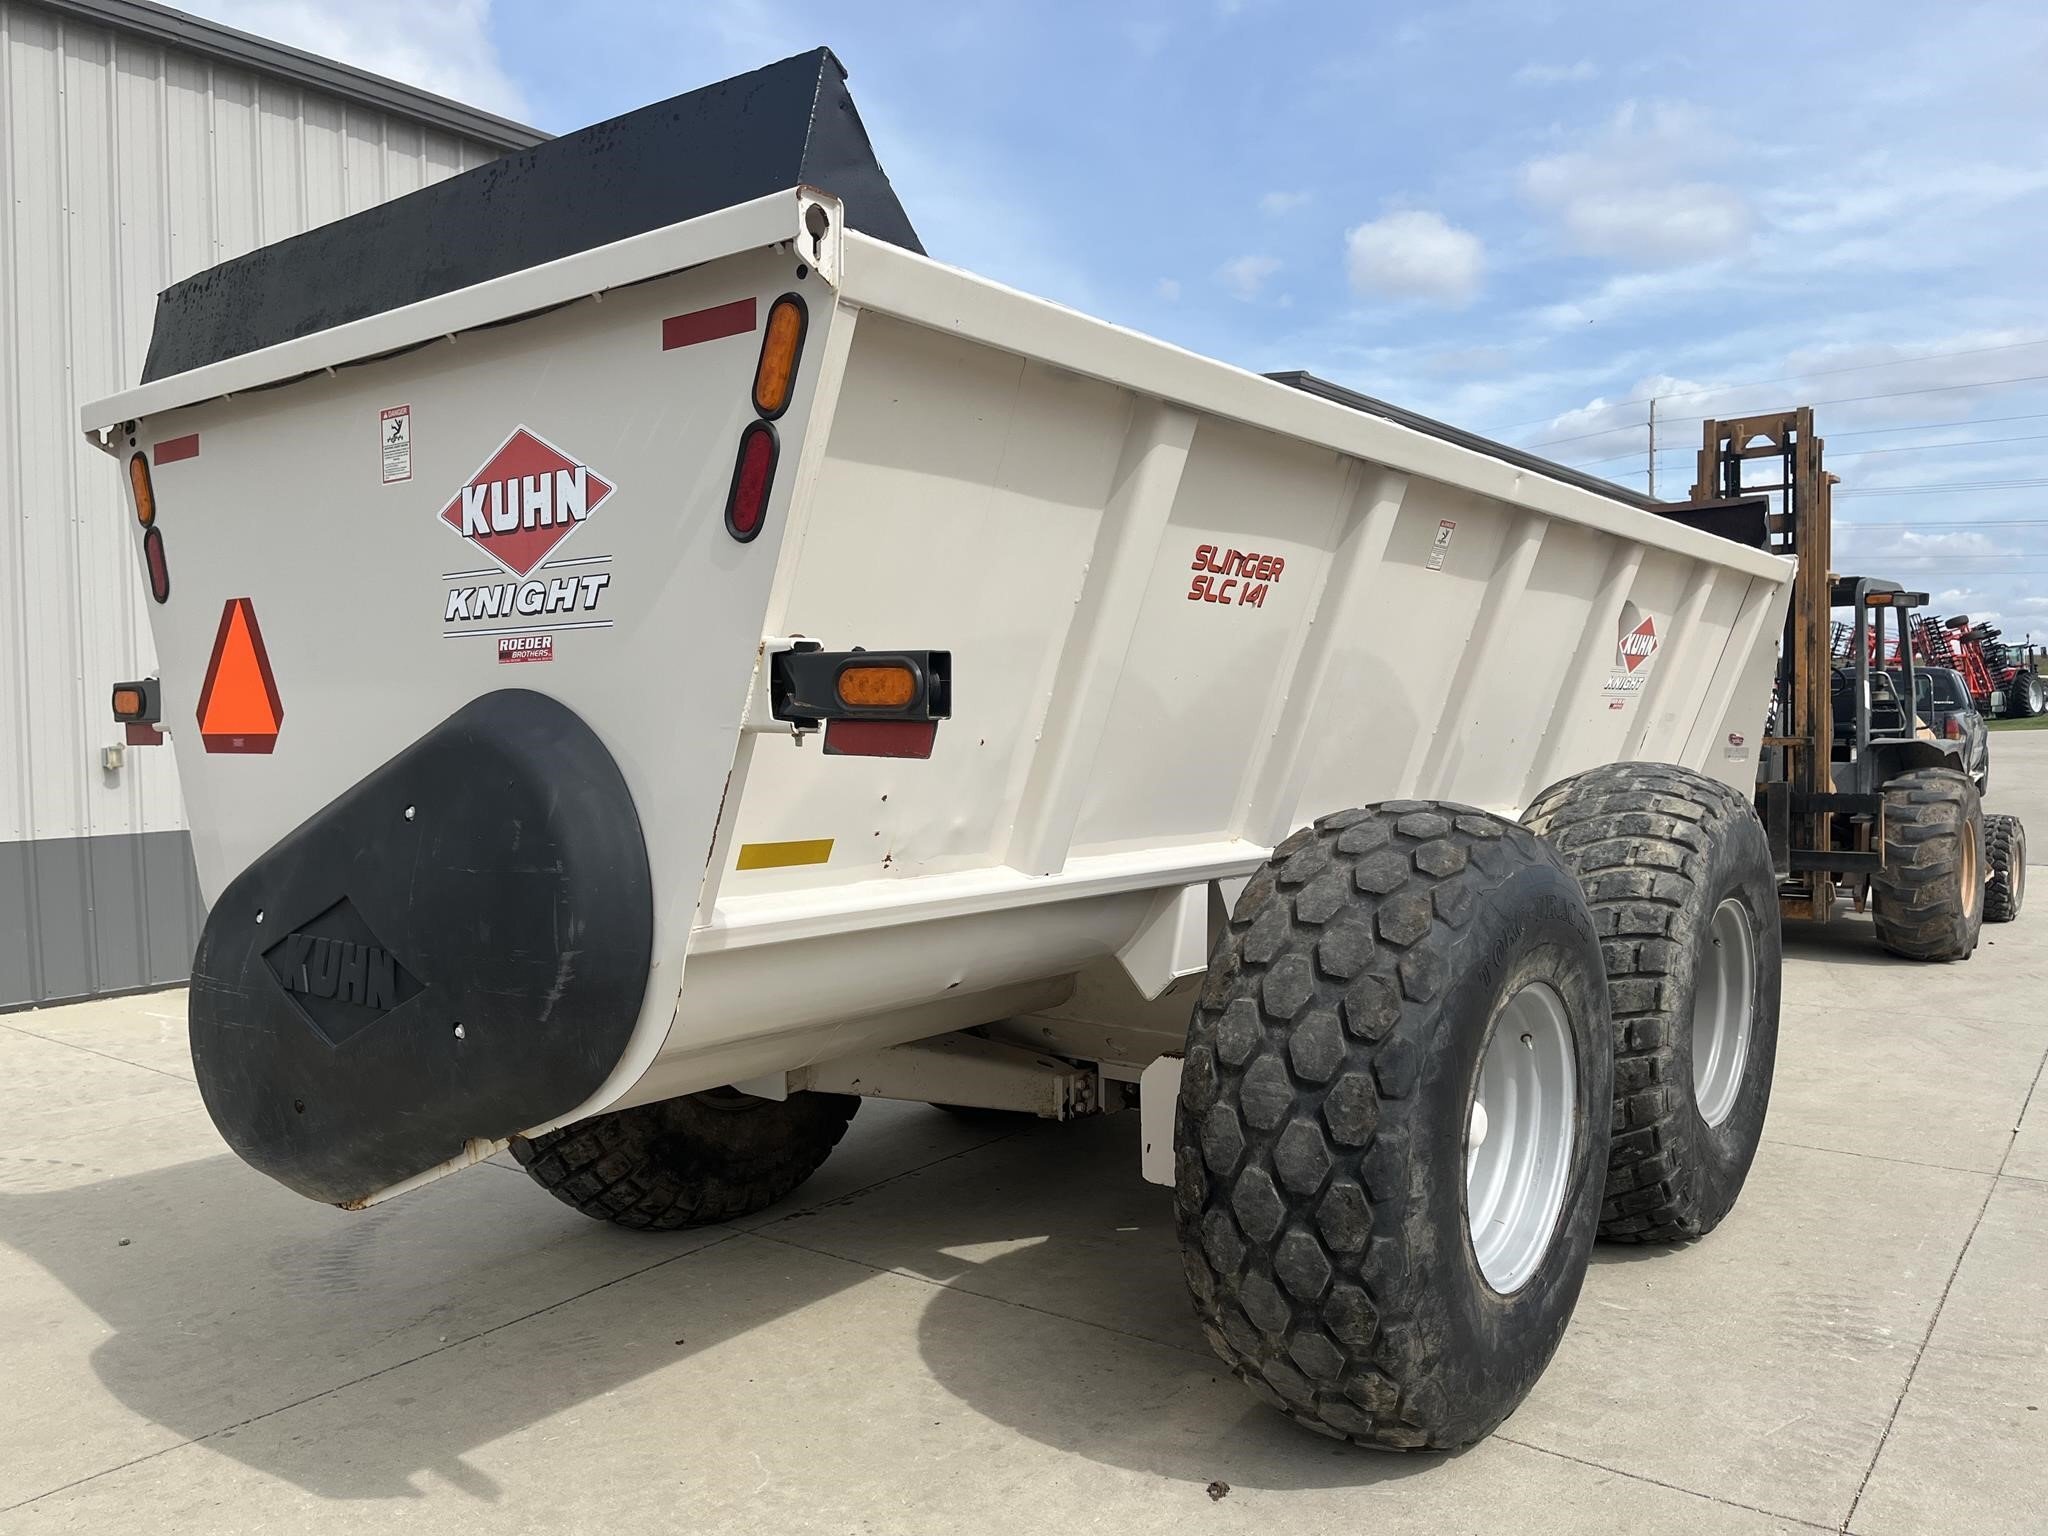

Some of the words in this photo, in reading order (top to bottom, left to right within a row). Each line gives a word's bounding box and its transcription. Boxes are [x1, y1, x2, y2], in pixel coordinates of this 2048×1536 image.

[462, 466, 587, 537] KUHN
[1191, 544, 1285, 583] SLINGER
[445, 574, 611, 622] KNIGHT
[1187, 575, 1238, 605] SLC
[1238, 582, 1269, 608] 141
[500, 637, 552, 651] ROEDER
[512, 650, 548, 659] BROTHERS
[1623, 634, 1656, 655] KUHN
[1604, 676, 1645, 690] KNIGHT
[282, 933, 398, 1011] KUHN
